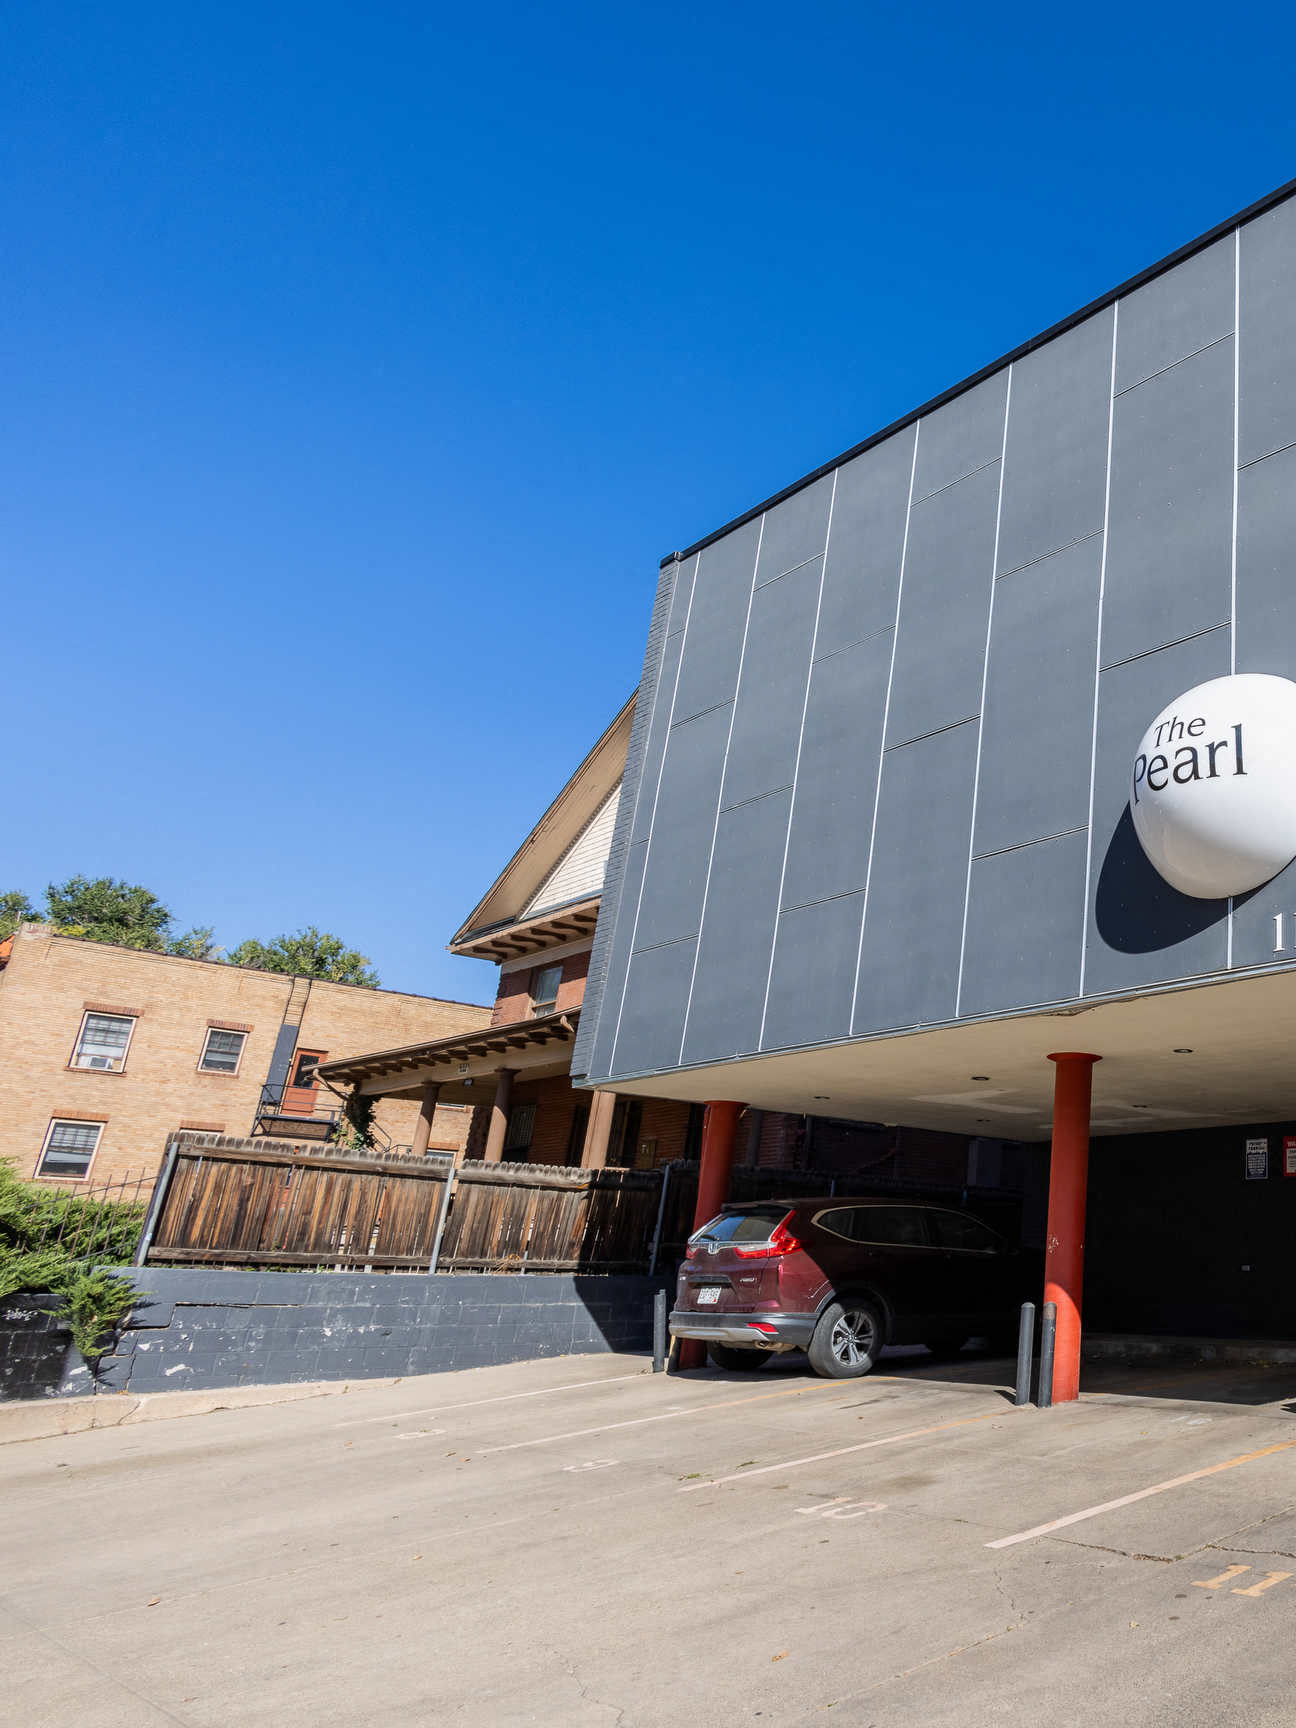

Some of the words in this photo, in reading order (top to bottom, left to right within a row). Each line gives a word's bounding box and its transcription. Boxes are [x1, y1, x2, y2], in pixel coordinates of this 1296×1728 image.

[1155, 716, 1206, 748] The
[1134, 723, 1248, 806] Pearl
[1190, 1564, 1295, 1597] 11
